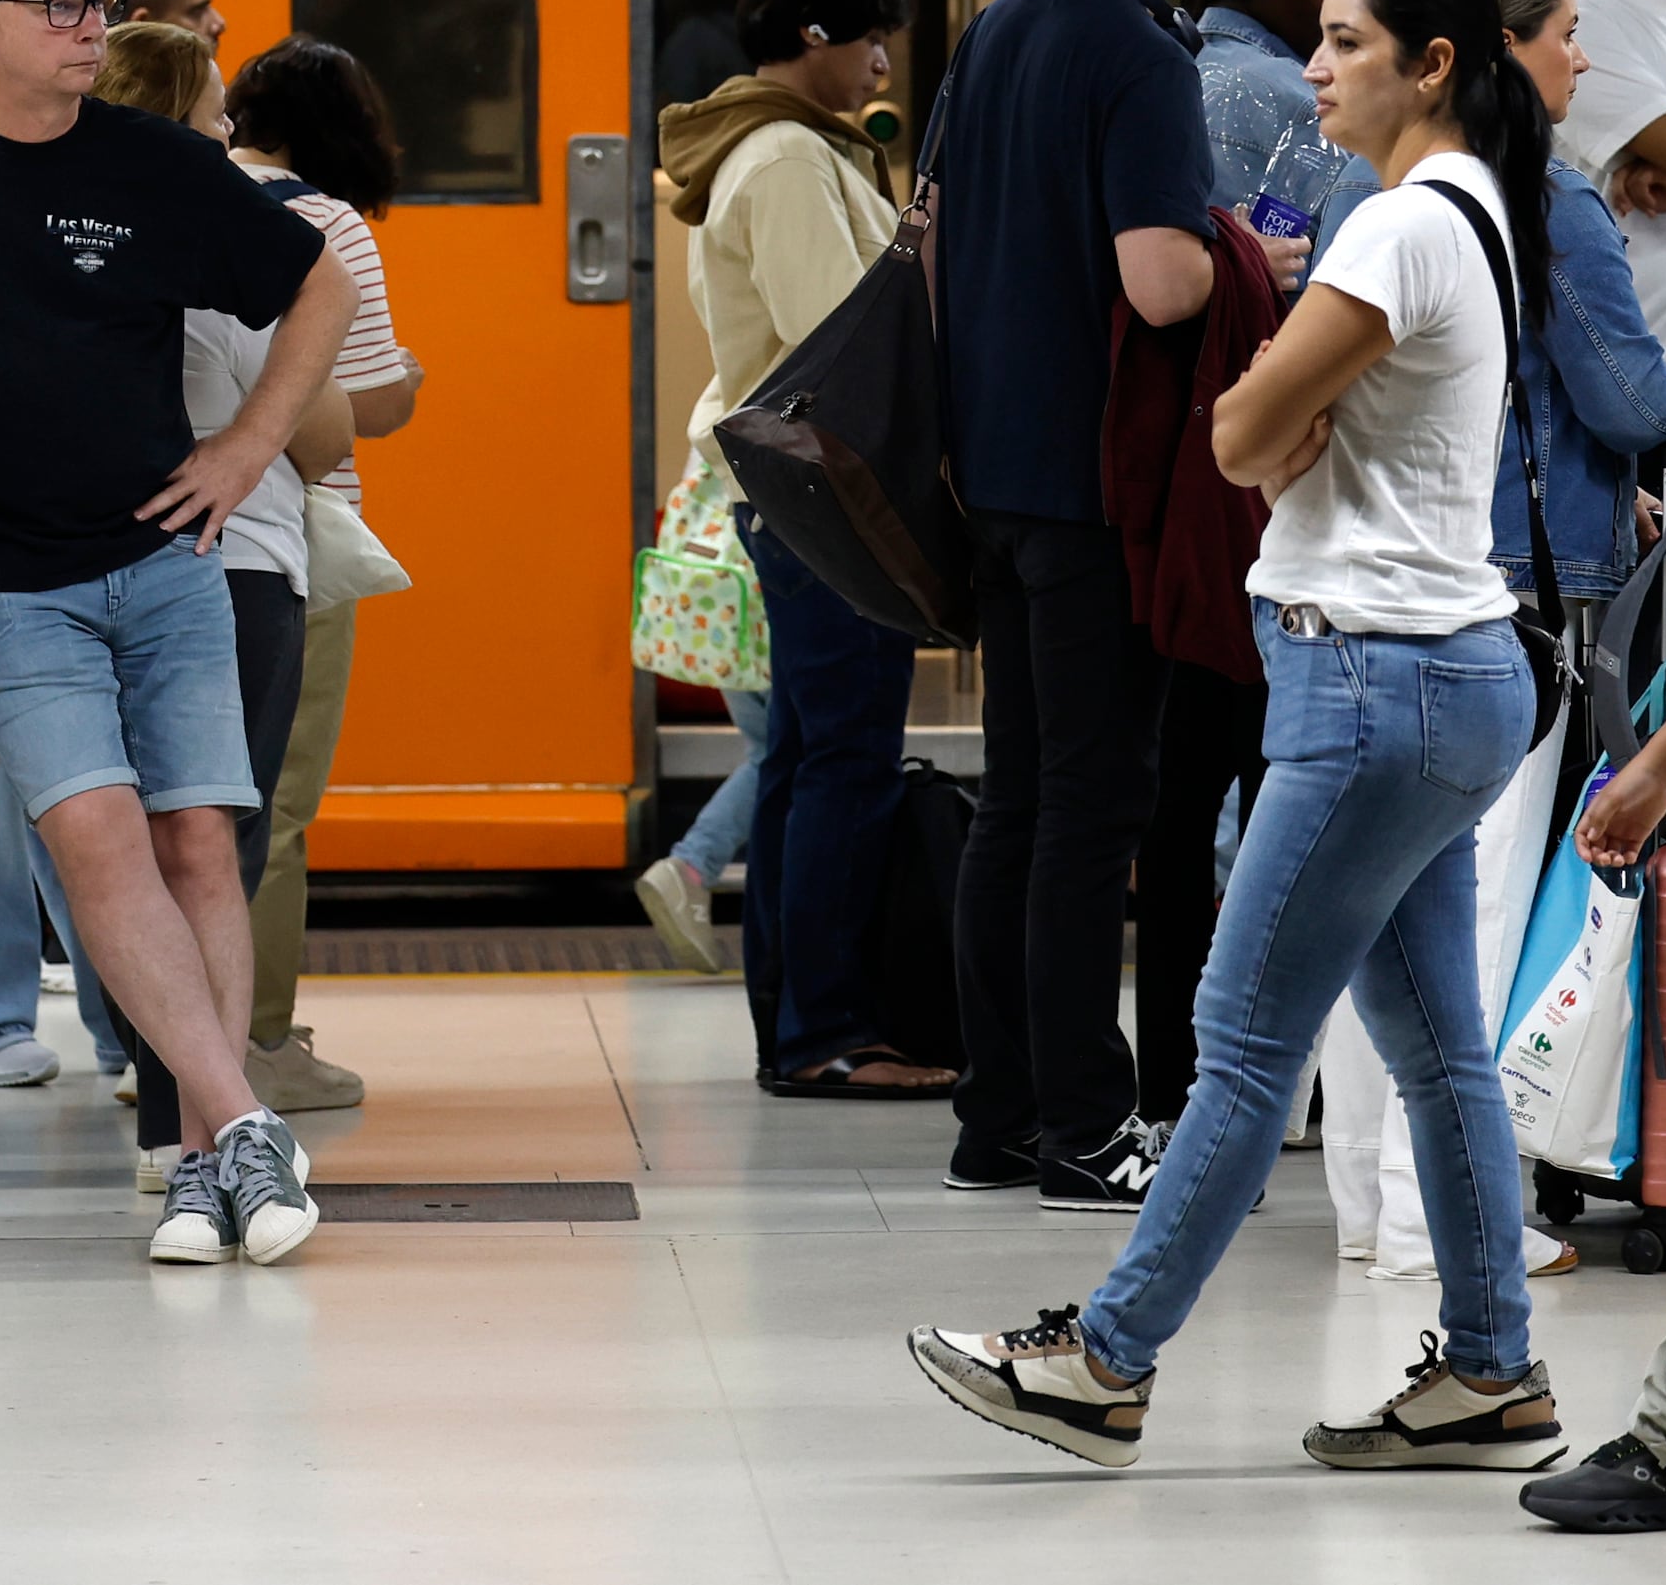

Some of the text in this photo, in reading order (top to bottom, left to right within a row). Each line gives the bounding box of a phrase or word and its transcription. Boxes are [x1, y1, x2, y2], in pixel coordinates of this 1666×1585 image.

[1265, 209, 1295, 233] Font
[63, 235, 114, 251] NEVADA
[1501, 1066, 1552, 1097] carrefour.es
[1106, 1154, 1160, 1191] N
